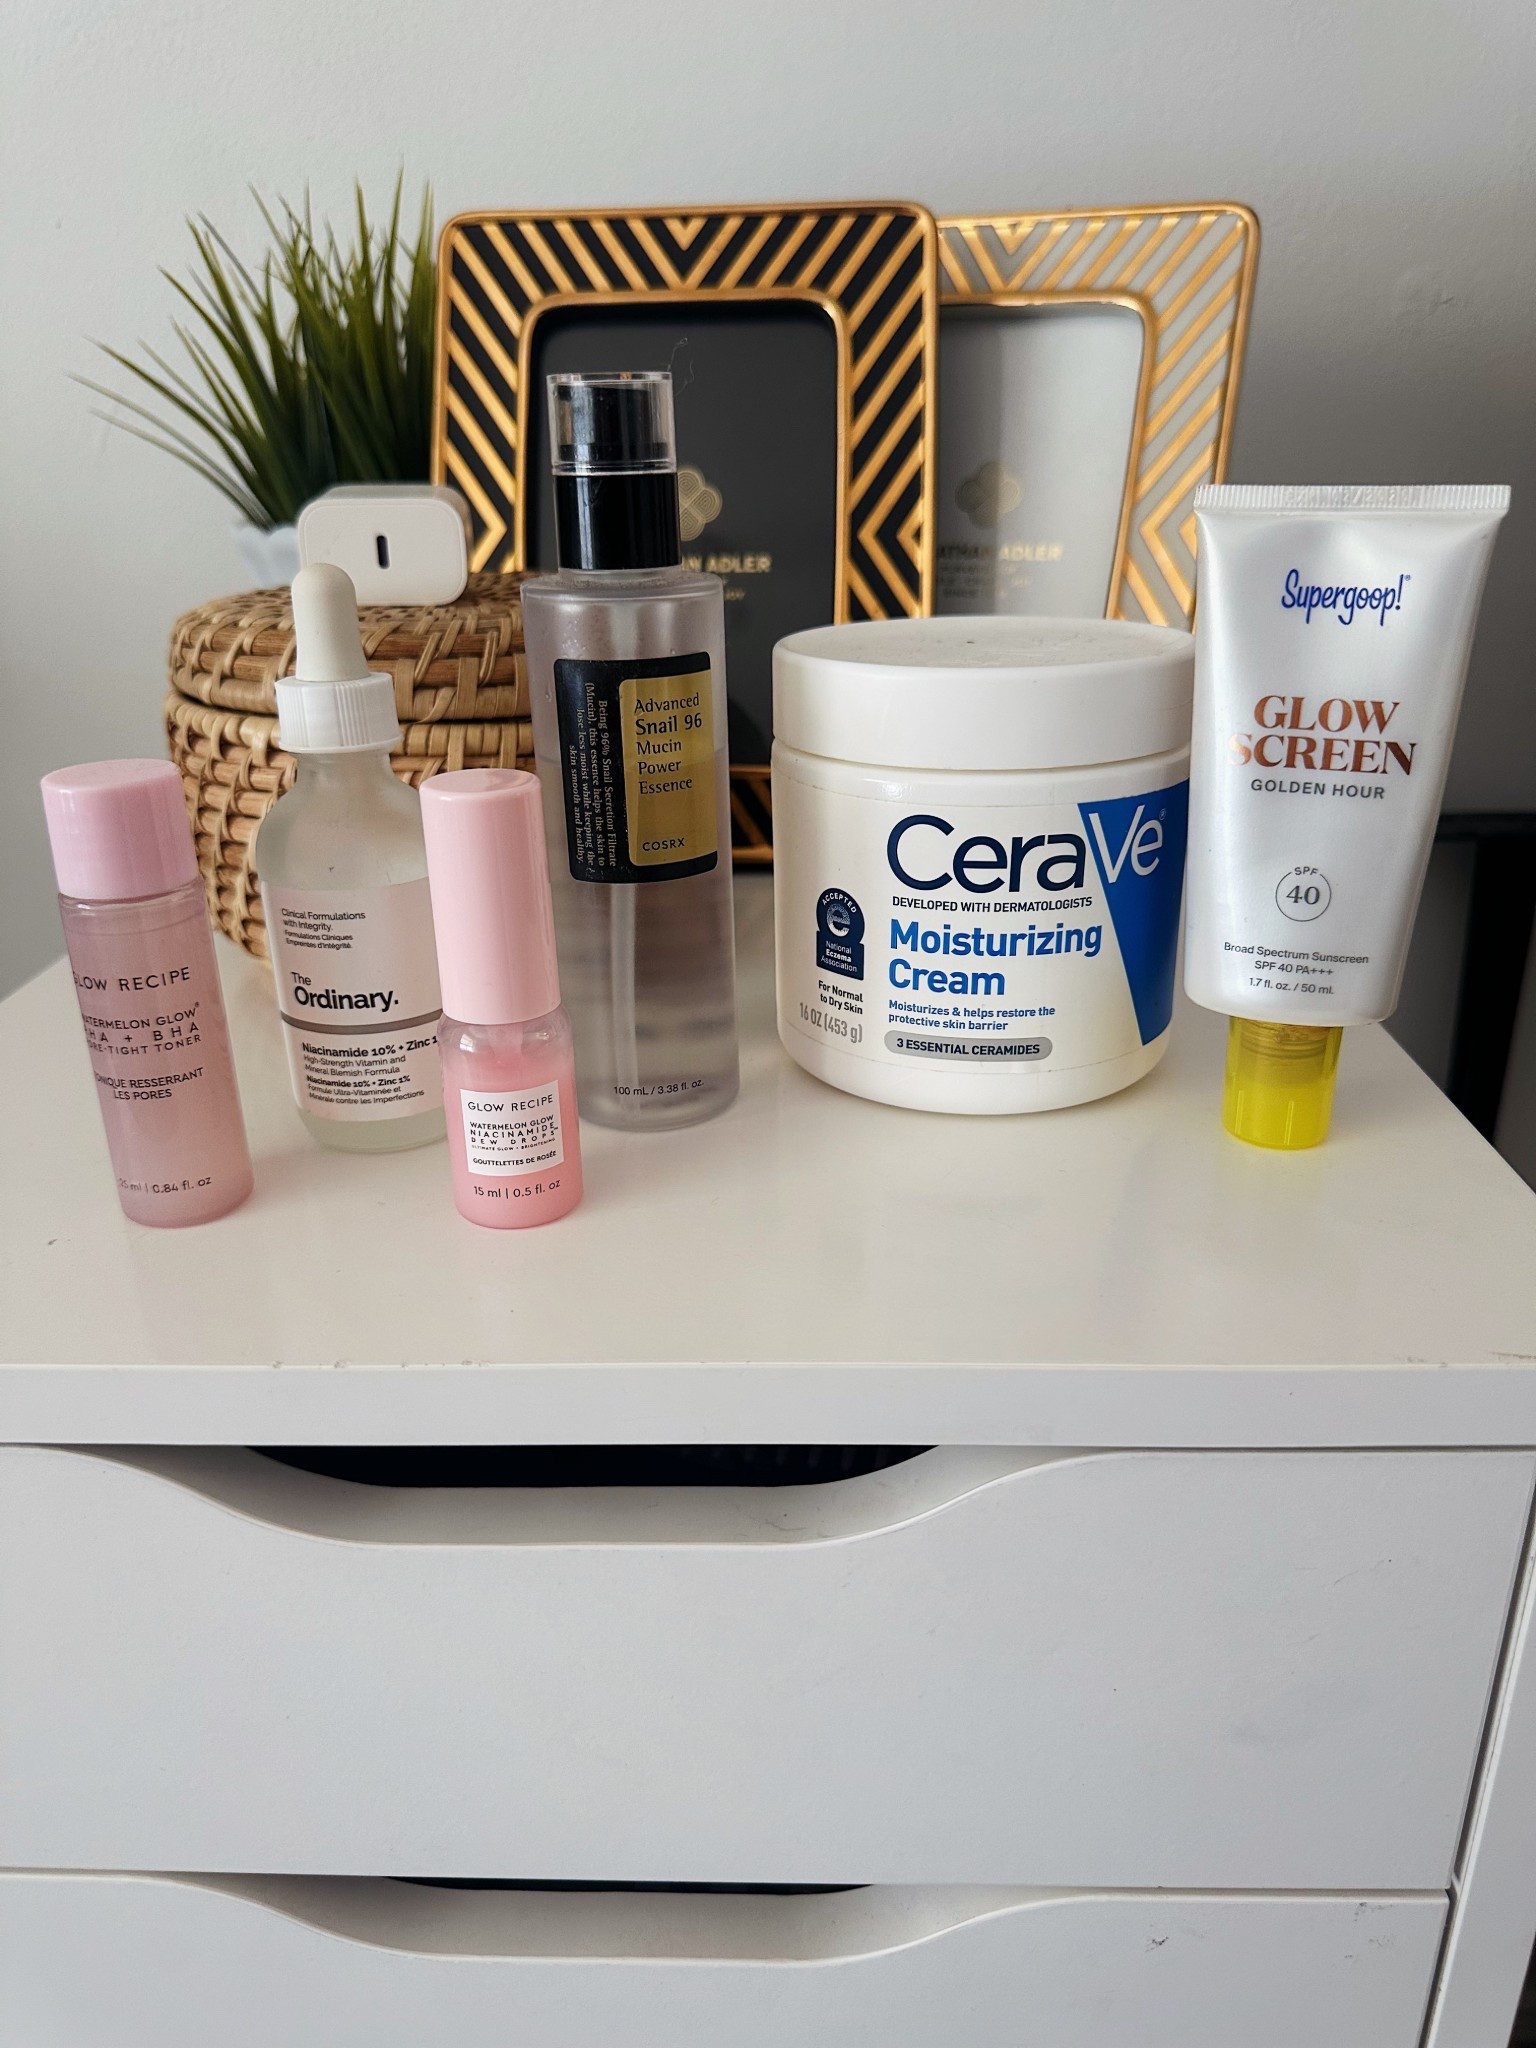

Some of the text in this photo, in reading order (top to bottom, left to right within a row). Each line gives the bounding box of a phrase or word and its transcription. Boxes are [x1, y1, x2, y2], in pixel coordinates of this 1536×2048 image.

[706, 552, 771, 573] ADLER
[1281, 568, 1404, 626] Supergoop!
[634, 692, 700, 713] Advanced
[576, 708, 585, 729] lose
[635, 712, 702, 736] Snail 96
[1254, 695, 1400, 735] GLOW
[589, 728, 598, 746] this
[569, 745, 578, 766] skin
[636, 739, 682, 756] Mucin
[1229, 732, 1418, 776] SCREEN
[580, 753, 589, 779] moist
[590, 749, 600, 786] essence
[637, 760, 682, 775] Power
[571, 768, 581, 804] smooth
[597, 700, 617, 867] Being 96% Snail Secretion Filtrate
[638, 777, 693, 795] Essence
[1251, 779, 1385, 800] GOLDEN HOUR
[582, 782, 591, 809] while
[593, 788, 603, 813] helps
[574, 806, 582, 825] and
[595, 817, 604, 832] the
[584, 811, 593, 848] keeping
[597, 834, 605, 854] skin
[642, 837, 685, 852] COSRX
[886, 805, 1163, 893] CeraVe
[587, 851, 595, 866] the
[598, 857, 605, 866] to
[1294, 866, 1318, 876] SPF
[822, 892, 857, 914] ACCEPTED
[1286, 885, 1320, 905] 40
[892, 896, 1093, 913] DEVELOPED WITH DERMATOLOGISTS
[281, 908, 366, 920] Clinical Formulations
[283, 919, 298, 928] with
[285, 930, 353, 942] Formulations Cliniques
[890, 918, 1103, 957] Moisturizing
[826, 940, 852, 954] National
[826, 949, 852, 963] Eczema
[1224, 942, 1369, 963] Broad Spectrum Sunscreen
[820, 955, 858, 972] Association
[1254, 960, 1333, 976] SPF 40 PA+++
[118, 966, 191, 991] RECIPE
[291, 971, 312, 986] The
[888, 958, 1005, 996] Cream
[1249, 977, 1334, 994] 1.7 fl. oz. 50 ml.
[295, 986, 399, 1012] Ordinary.
[818, 980, 863, 1002] For Normal
[820, 993, 863, 1015] to Dry Skin
[888, 1000, 1056, 1019] Moisturizes & helps restore the
[156, 1007, 196, 1026] GLOW
[800, 1002, 862, 1044] 16 OZ (453 g)
[888, 1014, 1008, 1030] protective skin barrier
[84, 1024, 109, 1042] HA
[88, 1034, 202, 1055] RE-TIGHT TONER
[302, 1042, 369, 1057] Niacinamide
[372, 1045, 396, 1056] 10%
[406, 1038, 431, 1051] Zinc
[896, 1038, 1040, 1056] 3 ESSENTIAL CERAMIDES
[304, 1054, 406, 1068] High-Strength Vitamin and
[130, 1067, 204, 1088] RESSERRANT
[305, 1064, 400, 1077] Mineral Blemish Formula
[306, 1075, 411, 1088] Niacinamide 10% Zinc 1%
[308, 1084, 332, 1095] Formule
[614, 1079, 704, 1095] 100 mL 3.38 fl. oz.
[114, 1088, 172, 1100] LES PORES
[336, 1095, 359, 1104] contre
[360, 1096, 372, 1104] les
[373, 1089, 425, 1104] Imperfections
[467, 1094, 554, 1112] GLOW RECIPE
[469, 1114, 554, 1130] WATERMELON GLOW
[470, 1122, 555, 1138] NIACINAMIDE
[471, 1131, 555, 1145] DEW DROPS
[473, 1157, 524, 1166] GOUTTELETTES
[536, 1150, 557, 1162] ROSÉE
[130, 1177, 212, 1193] ml 0.84 fl. oz
[473, 1180, 561, 1198] 15 ml 0.5 fl. oz
